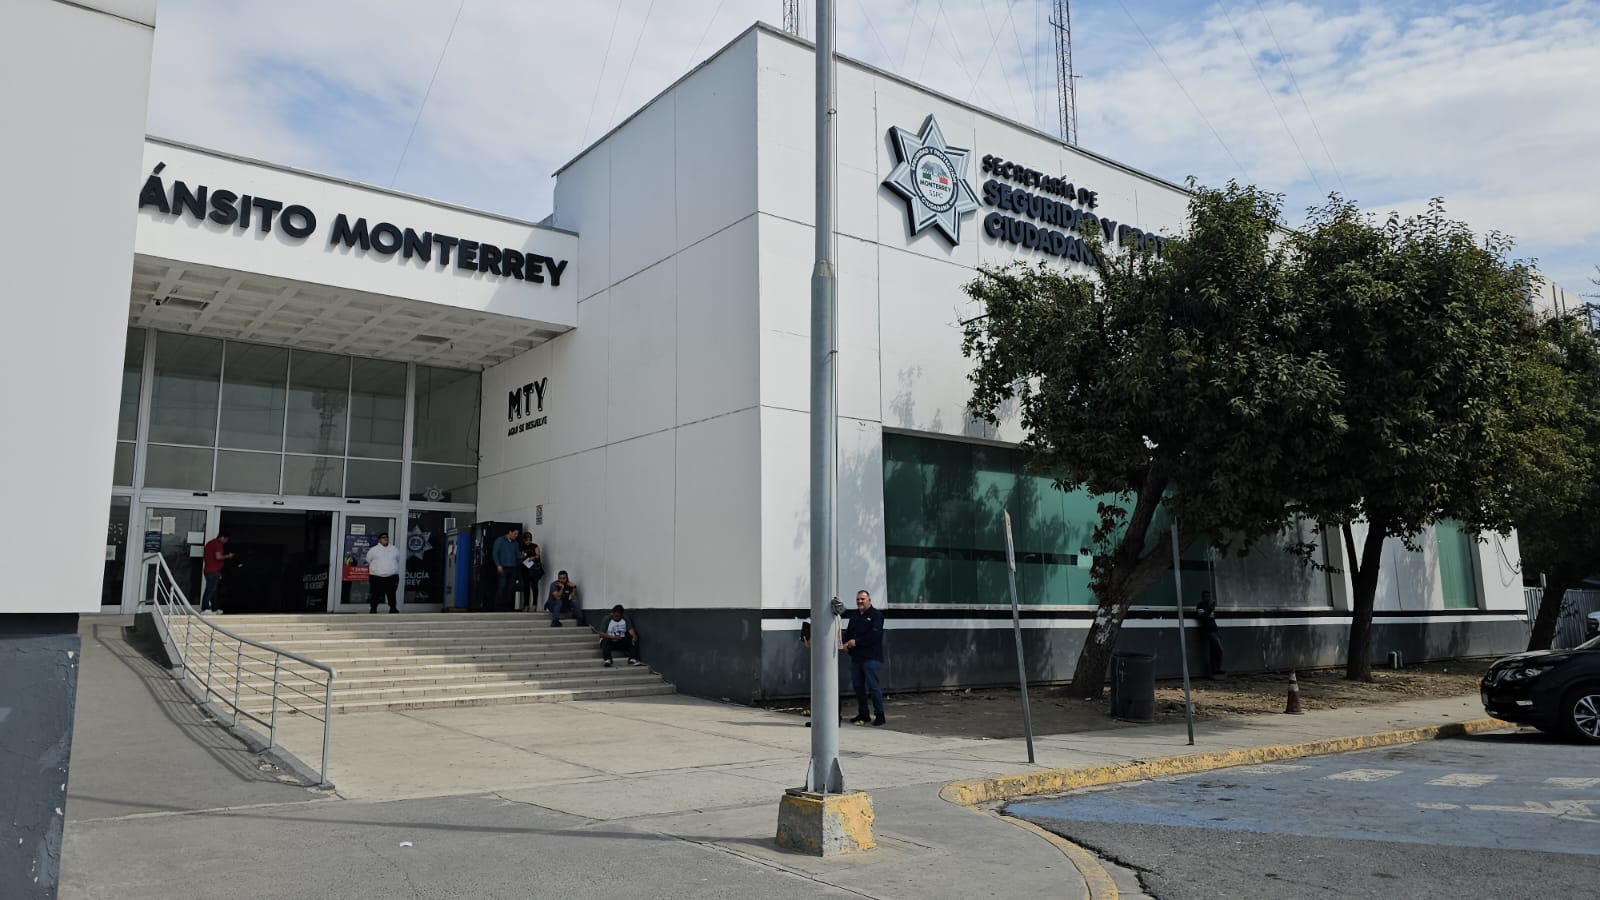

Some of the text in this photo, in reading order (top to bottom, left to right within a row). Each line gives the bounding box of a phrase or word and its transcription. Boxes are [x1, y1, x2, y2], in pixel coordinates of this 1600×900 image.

[920, 180, 951, 192] MONTERREY
[982, 154, 1098, 209] SECRETARÍA DE
[983, 179, 1100, 236] SEGURIDAD
[1100, 217, 1117, 243] Y
[330, 213, 568, 286] MONTERREY
[508, 377, 548, 422] MTY
